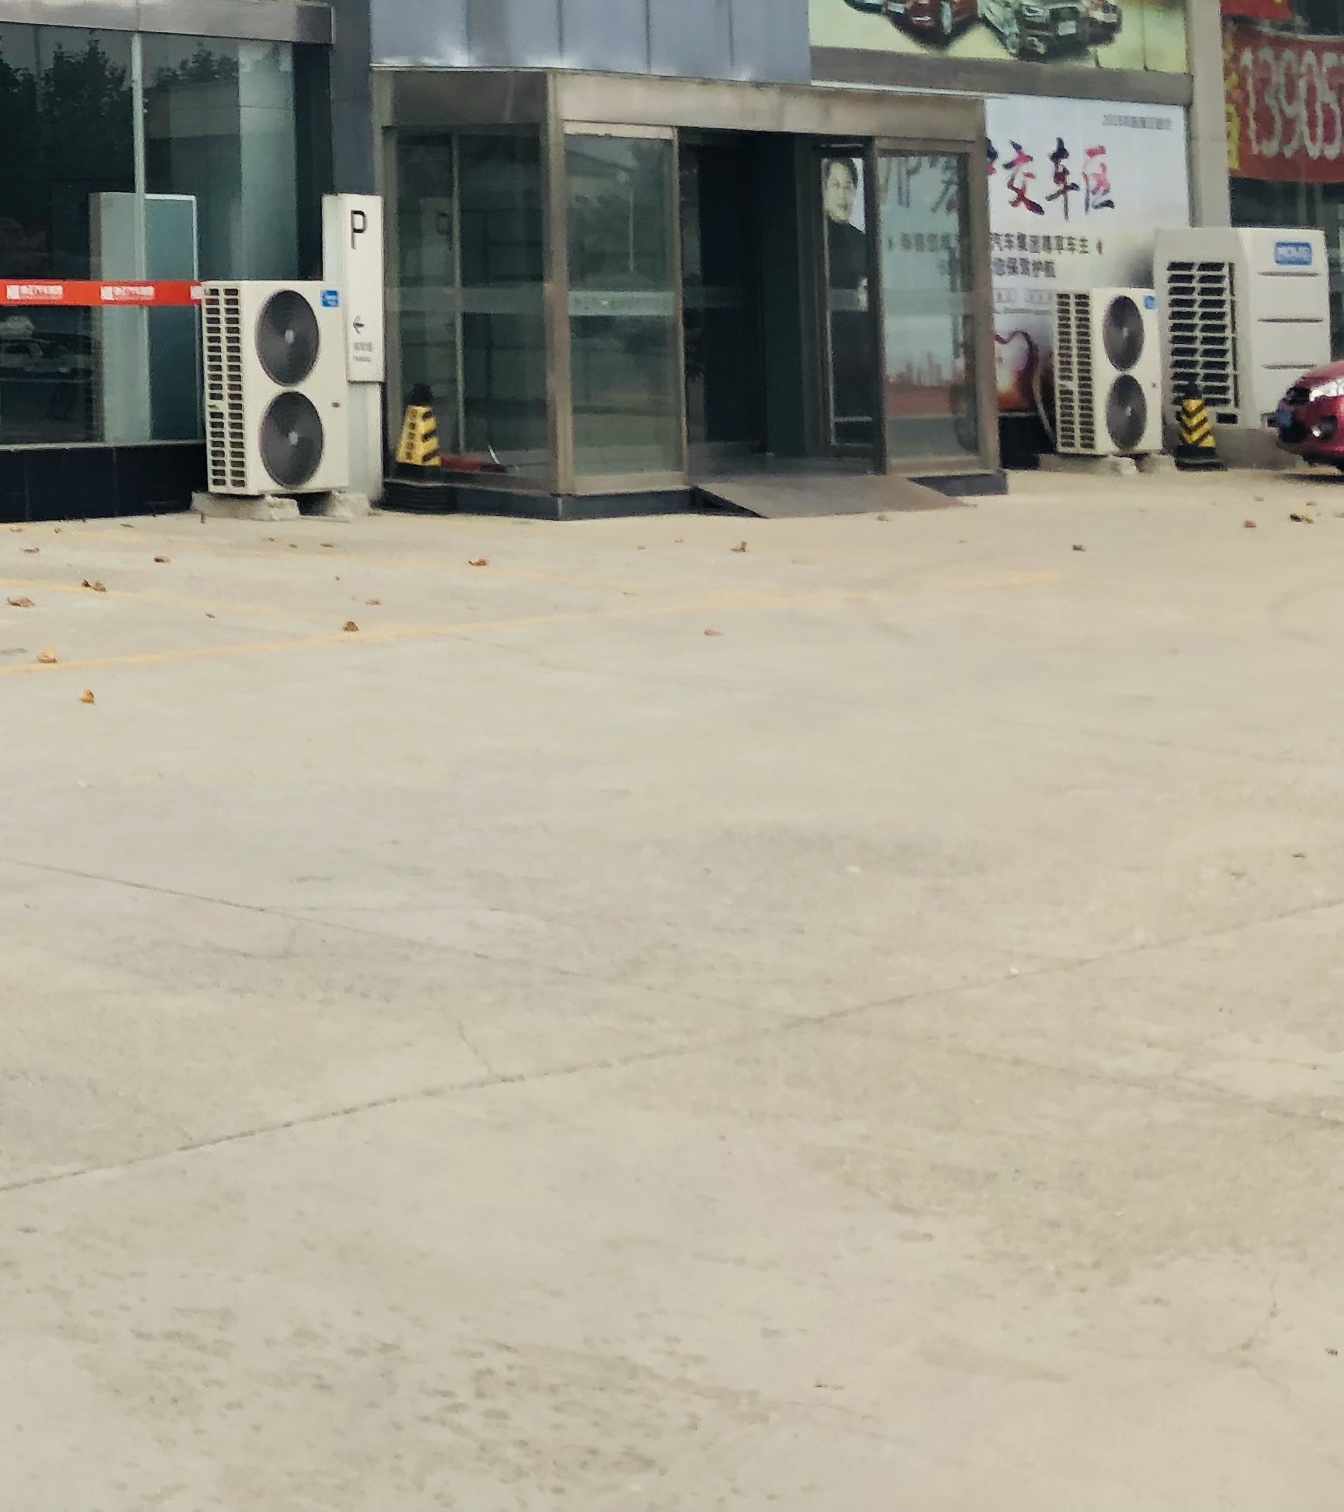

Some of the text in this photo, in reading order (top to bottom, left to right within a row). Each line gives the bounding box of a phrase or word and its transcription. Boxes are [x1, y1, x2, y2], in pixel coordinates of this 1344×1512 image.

[1240, 46, 1344, 162] 13905
[986, 136, 1115, 222] 交车区
